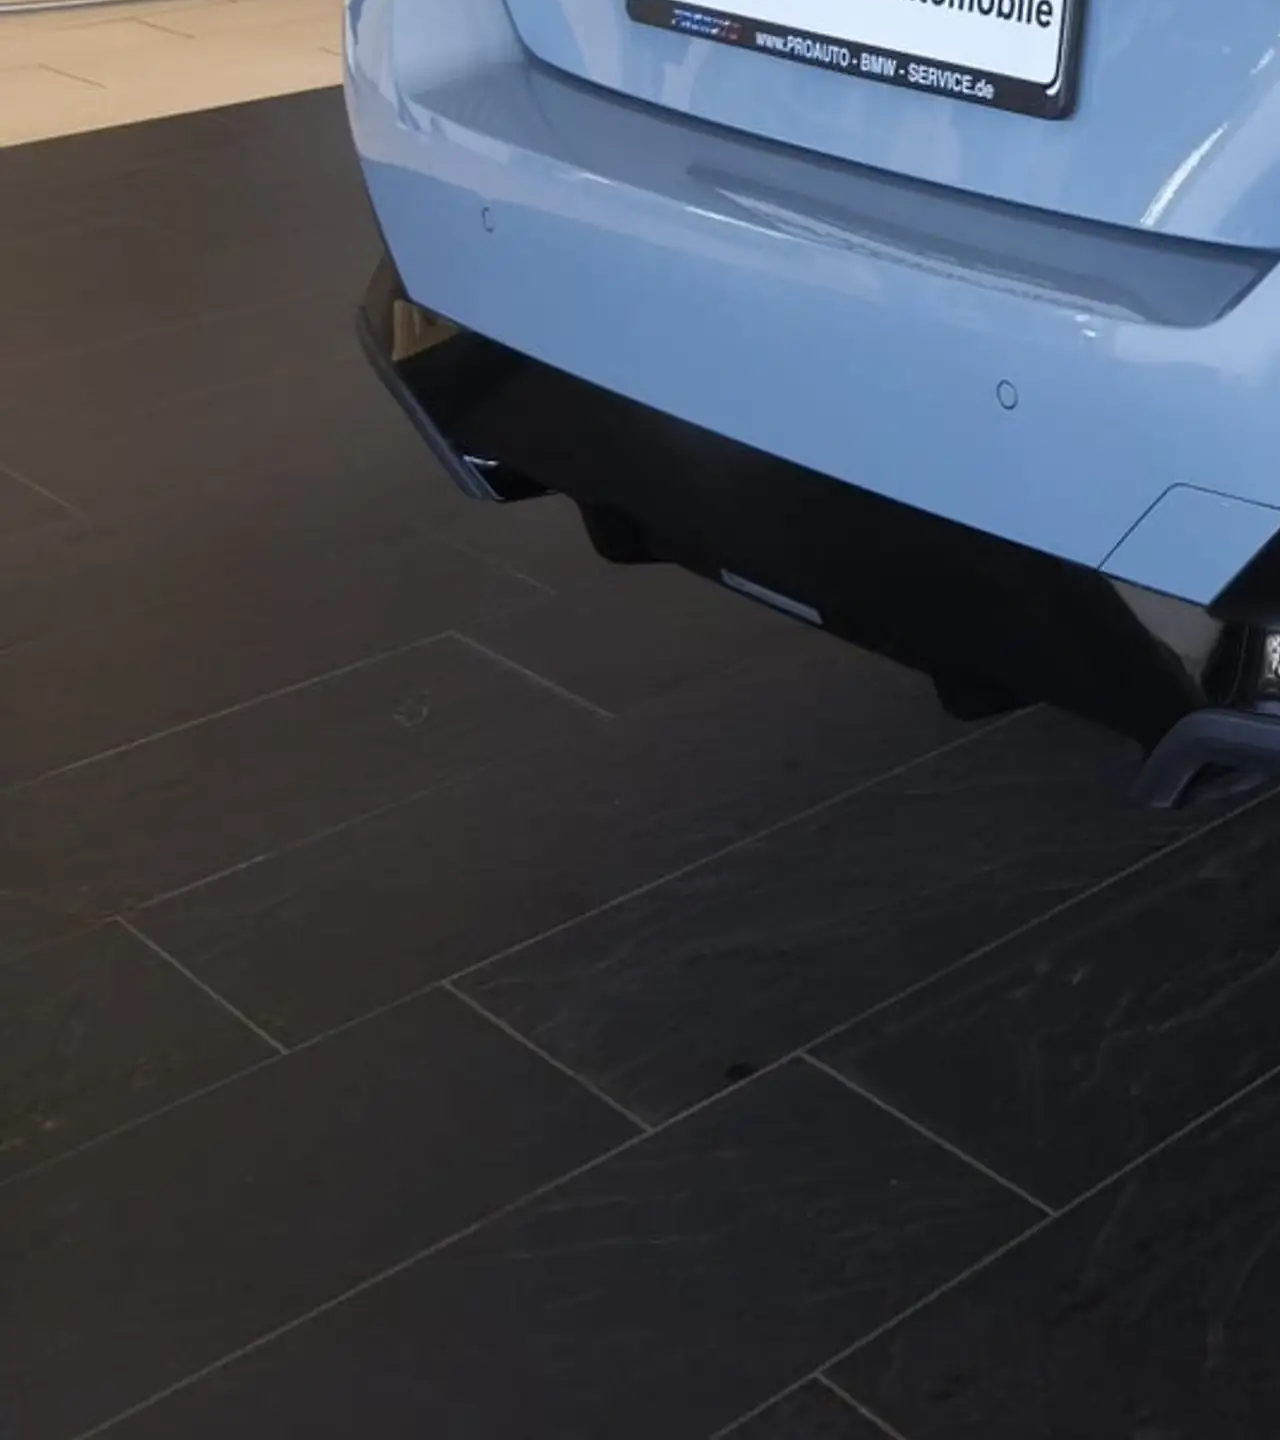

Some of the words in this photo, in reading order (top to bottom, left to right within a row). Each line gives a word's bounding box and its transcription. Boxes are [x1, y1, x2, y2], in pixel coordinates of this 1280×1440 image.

[754, 30, 851, 67] www.PROAUTO
[859, 53, 897, 78] BMW
[907, 62, 996, 101] SERVICE.de
